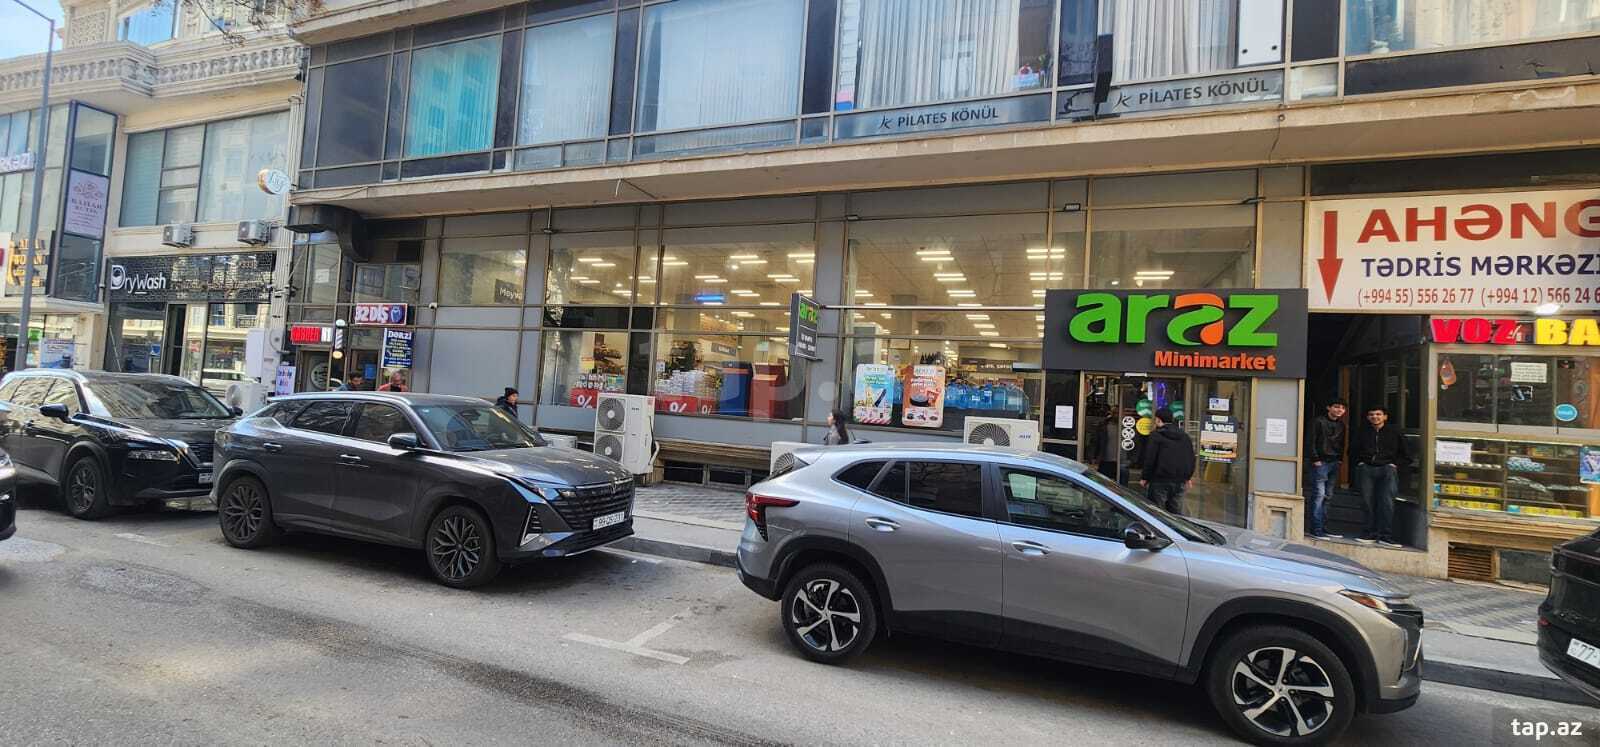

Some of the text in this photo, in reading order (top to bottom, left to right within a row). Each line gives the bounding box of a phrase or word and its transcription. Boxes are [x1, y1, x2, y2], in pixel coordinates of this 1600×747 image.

[1139, 77, 1269, 104] PİLATES KÖNÜL
[898, 104, 999, 127] PİLATES KÖNÜL
[1357, 198, 1600, 244] AHƏNG
[1361, 251, 1462, 277] TƏDRİS
[111, 265, 166, 294] DryWash
[1357, 286, 1392, 307] (+994
[1395, 287, 1414, 307] 55)
[1417, 288, 1439, 304] 556
[1442, 288, 1456, 304] 26
[1458, 287, 1474, 304] 77
[1481, 286, 1518, 307] (+994
[1522, 286, 1543, 307] 12)
[1547, 287, 1571, 304] 566
[1574, 287, 1591, 304] 24
[1069, 292, 1279, 347] araz
[1430, 318, 1516, 344] VOZ
[1154, 350, 1276, 370] Minimarket
